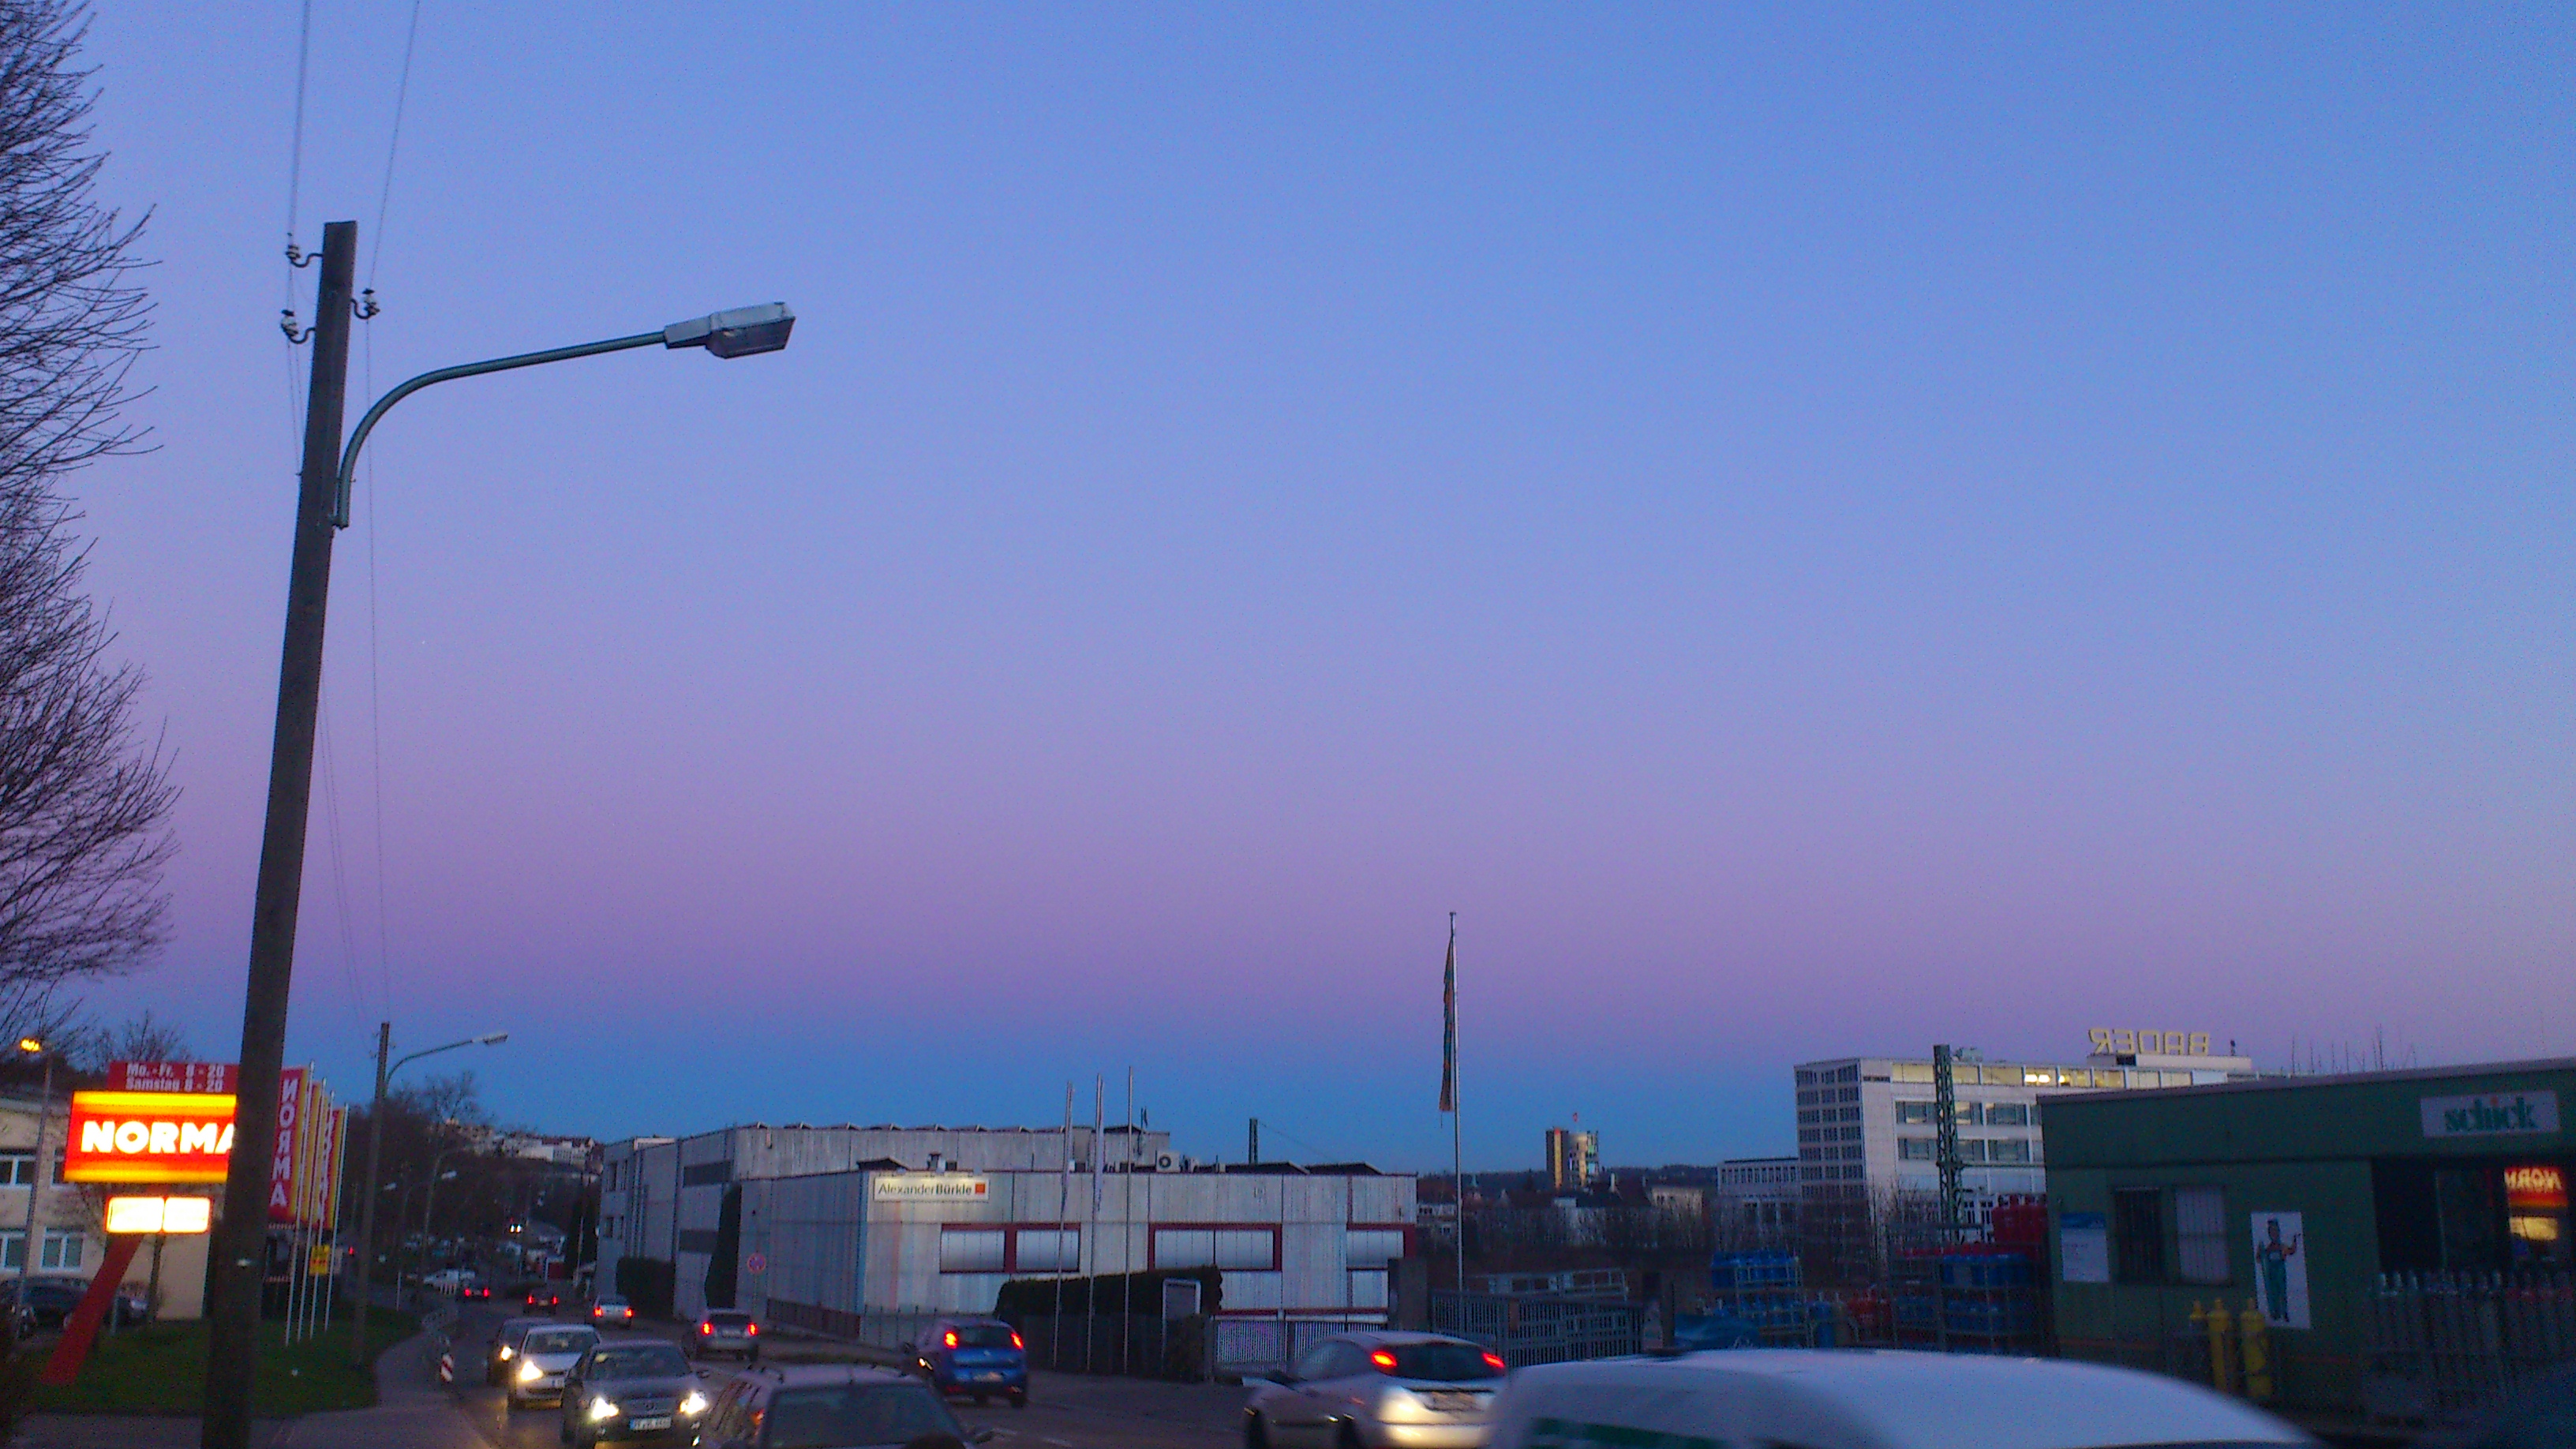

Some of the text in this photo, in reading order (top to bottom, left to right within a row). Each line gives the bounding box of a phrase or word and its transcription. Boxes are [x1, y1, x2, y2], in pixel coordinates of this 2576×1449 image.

[185, 1063, 195, 1077] 8
[207, 1063, 225, 1078] 20
[125, 1076, 181, 1092] Samstag
[184, 1078, 193, 1092] 8
[205, 1078, 223, 1093] 20
[2444, 1095, 2539, 1132] schick
